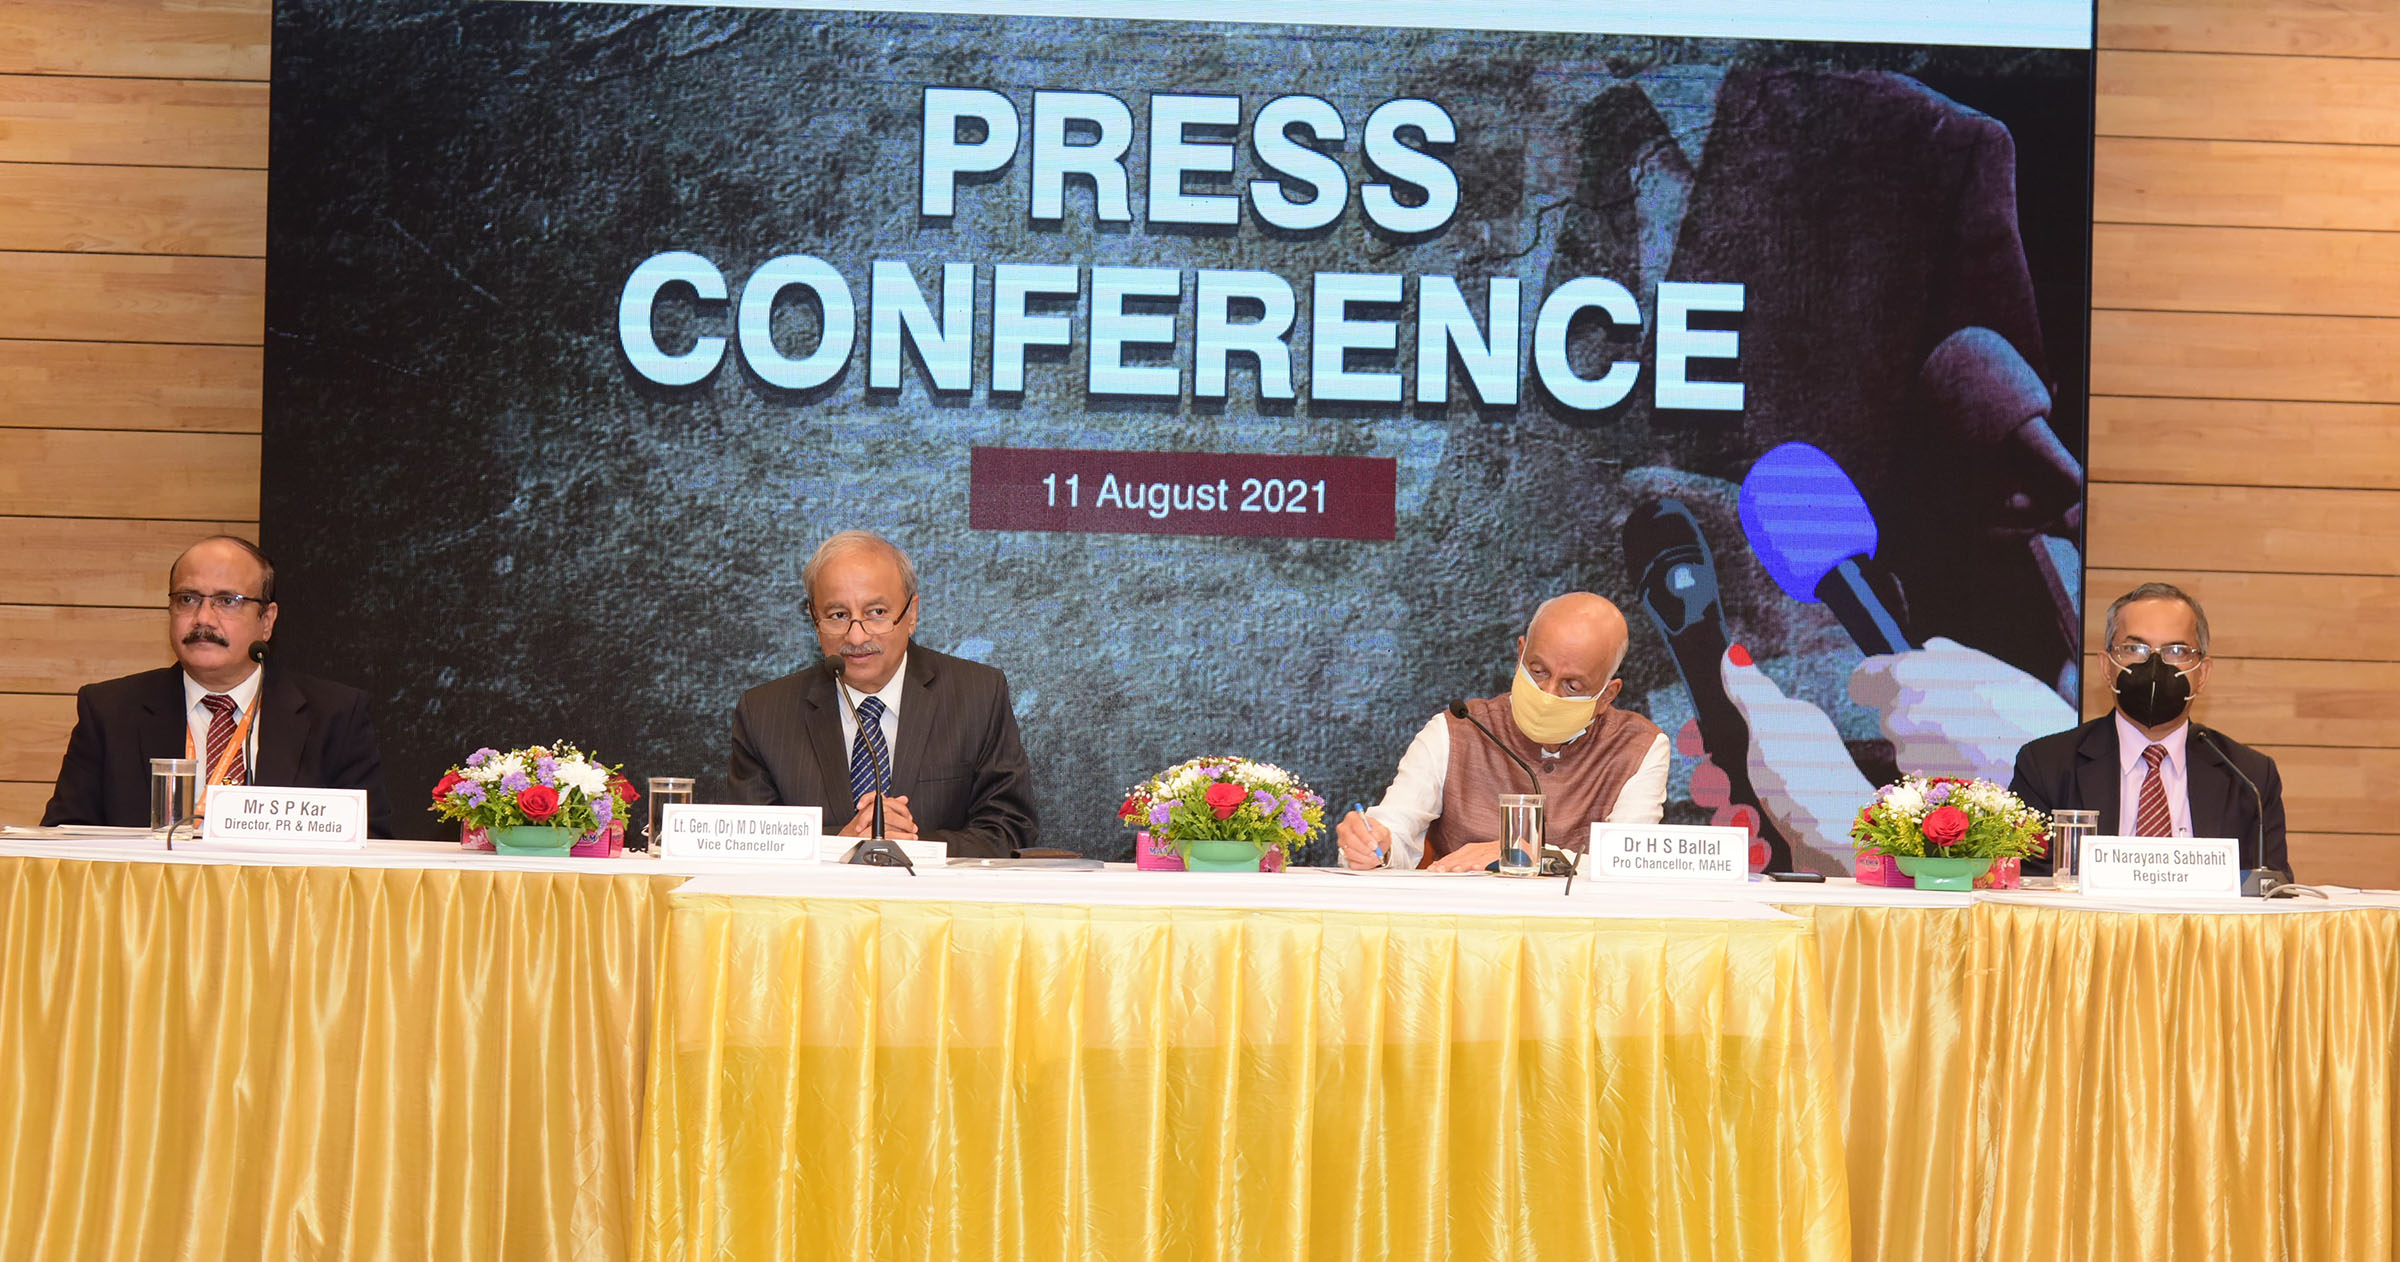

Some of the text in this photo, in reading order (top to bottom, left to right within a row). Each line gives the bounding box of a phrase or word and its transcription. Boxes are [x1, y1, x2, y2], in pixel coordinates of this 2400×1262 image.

[922, 86, 1459, 233] PRESS
[618, 250, 1746, 411] CONFERENCE
[1042, 472, 1327, 519] 11 August 2021
[243, 799, 327, 817] Mr S P Kar
[275, 819, 291, 832] PR
[295, 820, 303, 832] &
[307, 821, 343, 833] Media
[673, 818, 810, 837] Lt. Gen. (Dr) M D Venkatesh
[696, 838, 785, 852] Vice Chancellor
[1624, 837, 1721, 855] Dr H S Ballal
[1612, 856, 1732, 872] Pro Chancellor, MAHE
[2094, 848, 2227, 867] Dr Narayana Sabhahit
[2132, 869, 2190, 885] Registrar
